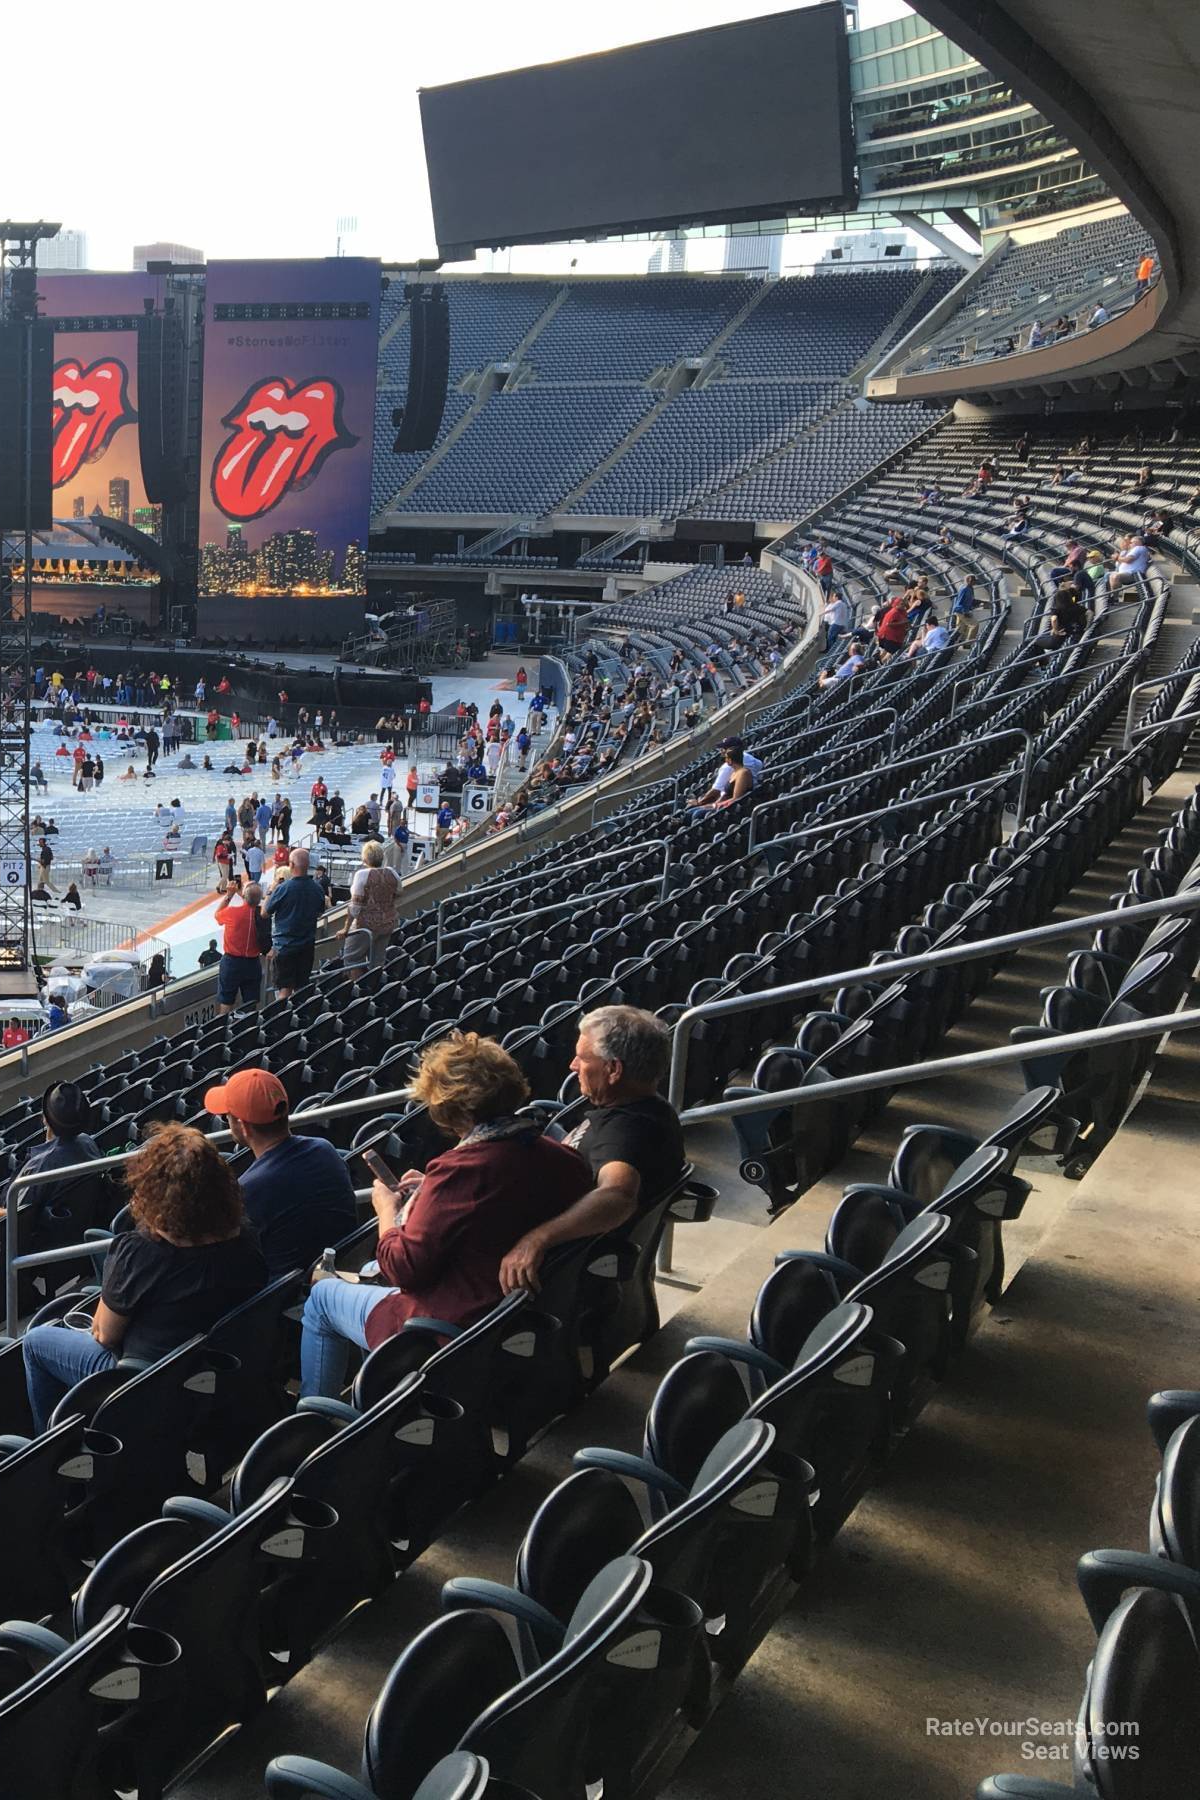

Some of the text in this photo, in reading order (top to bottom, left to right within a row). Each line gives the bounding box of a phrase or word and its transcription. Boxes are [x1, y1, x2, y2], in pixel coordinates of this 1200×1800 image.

[471, 793, 485, 810] 6
[160, 863, 168, 876] A
[202, 1004, 215, 1024] 212
